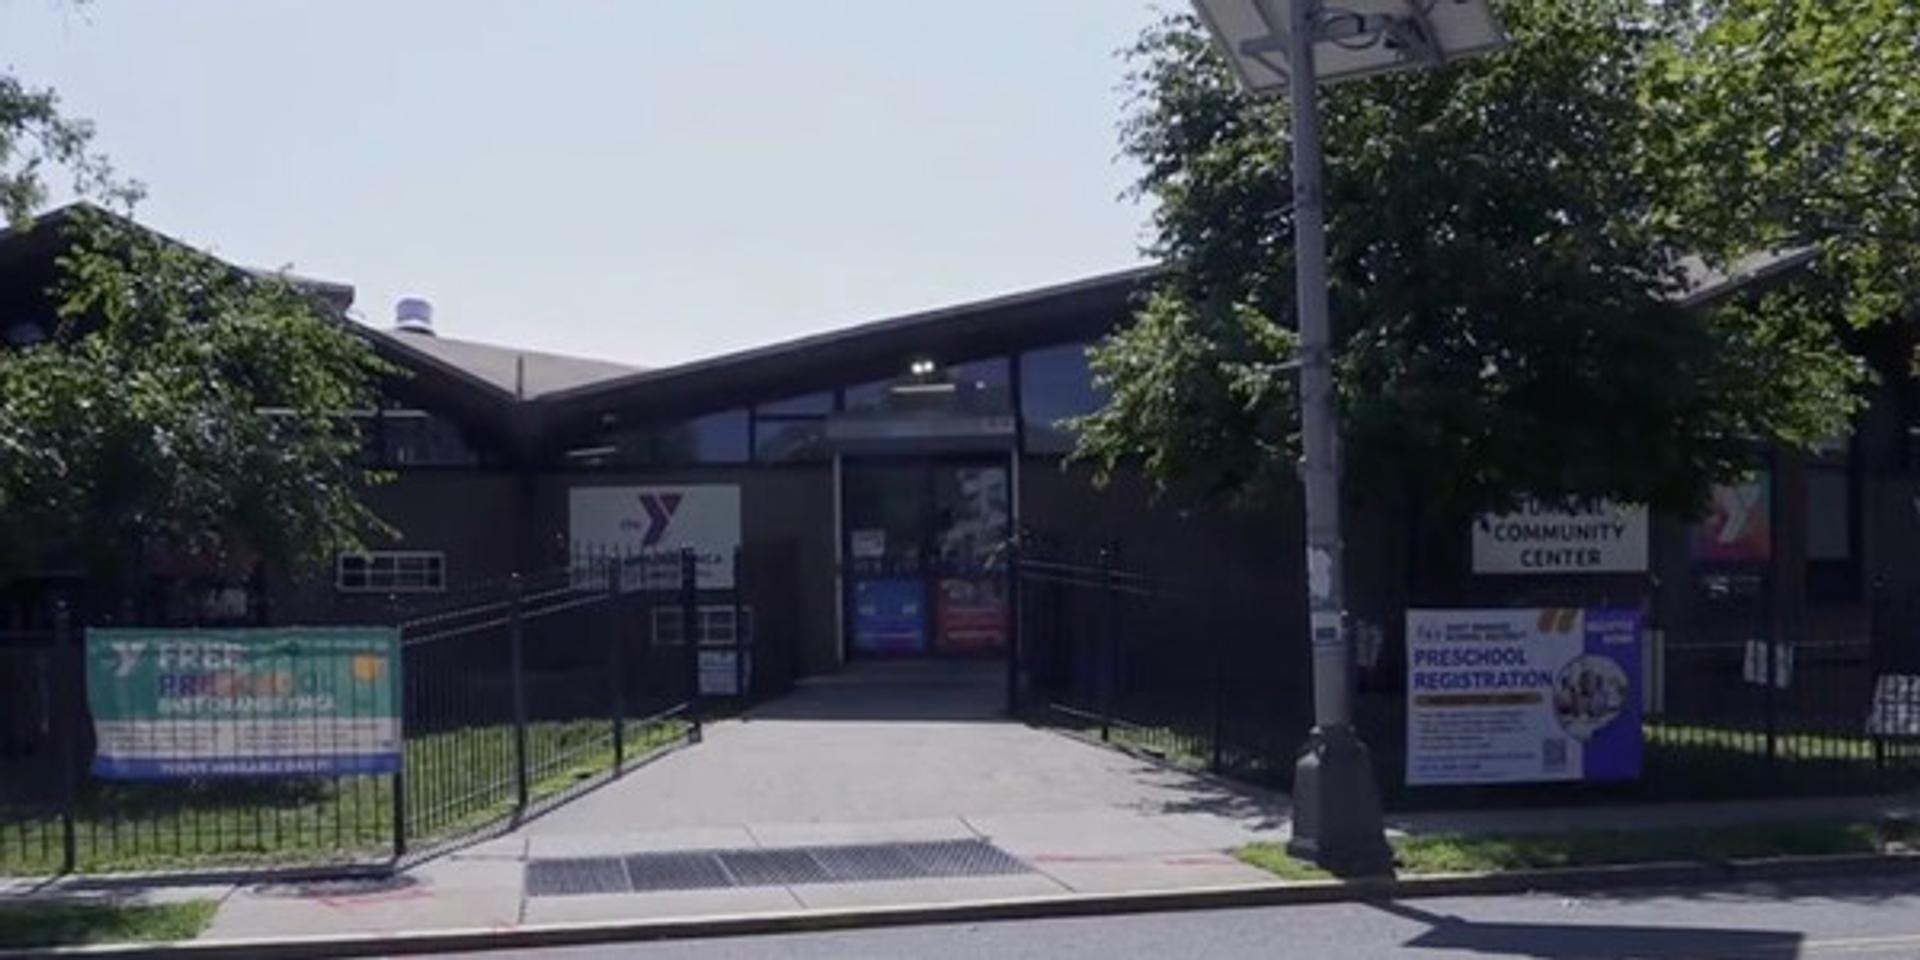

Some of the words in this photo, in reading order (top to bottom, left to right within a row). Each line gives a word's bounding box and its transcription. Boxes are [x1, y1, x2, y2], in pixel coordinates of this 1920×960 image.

[1494, 522, 1625, 543] COMMUNITY
[1520, 549, 1602, 568] CENTER
[158, 641, 242, 669] FREE
[1414, 647, 1527, 667] PRESCHOOL
[1413, 670, 1554, 690] REGISTRATION
